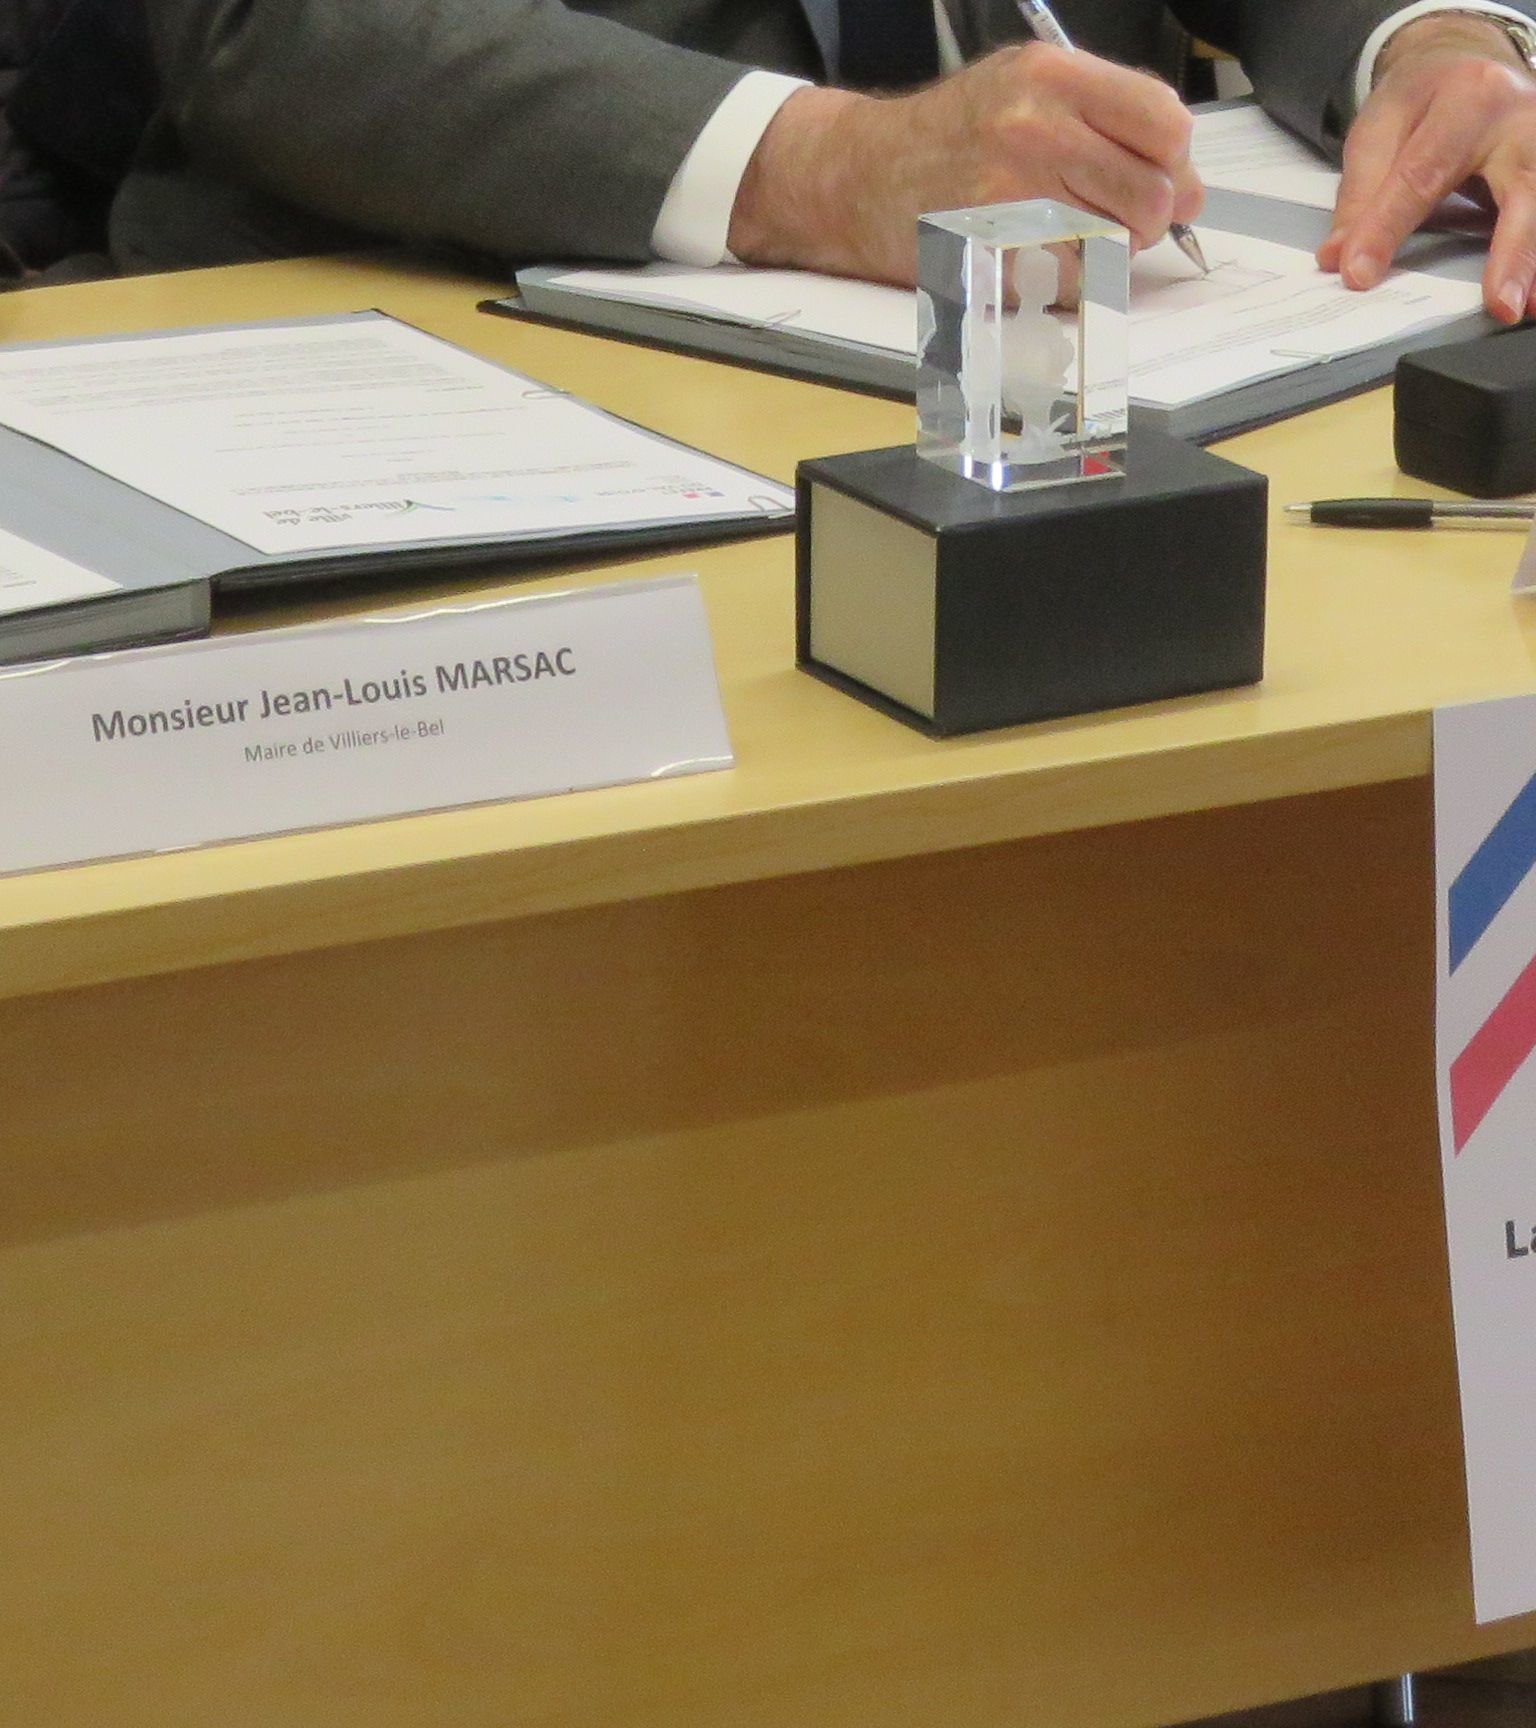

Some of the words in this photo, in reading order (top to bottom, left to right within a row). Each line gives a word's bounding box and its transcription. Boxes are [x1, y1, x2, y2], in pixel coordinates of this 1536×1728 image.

[91, 699, 249, 743] Monsieur
[260, 669, 427, 720] Jean-Louis
[435, 647, 577, 694] MARSAC
[244, 742, 298, 763] Maire
[302, 737, 325, 756] de
[328, 719, 446, 751] Villiers-le-Bel
